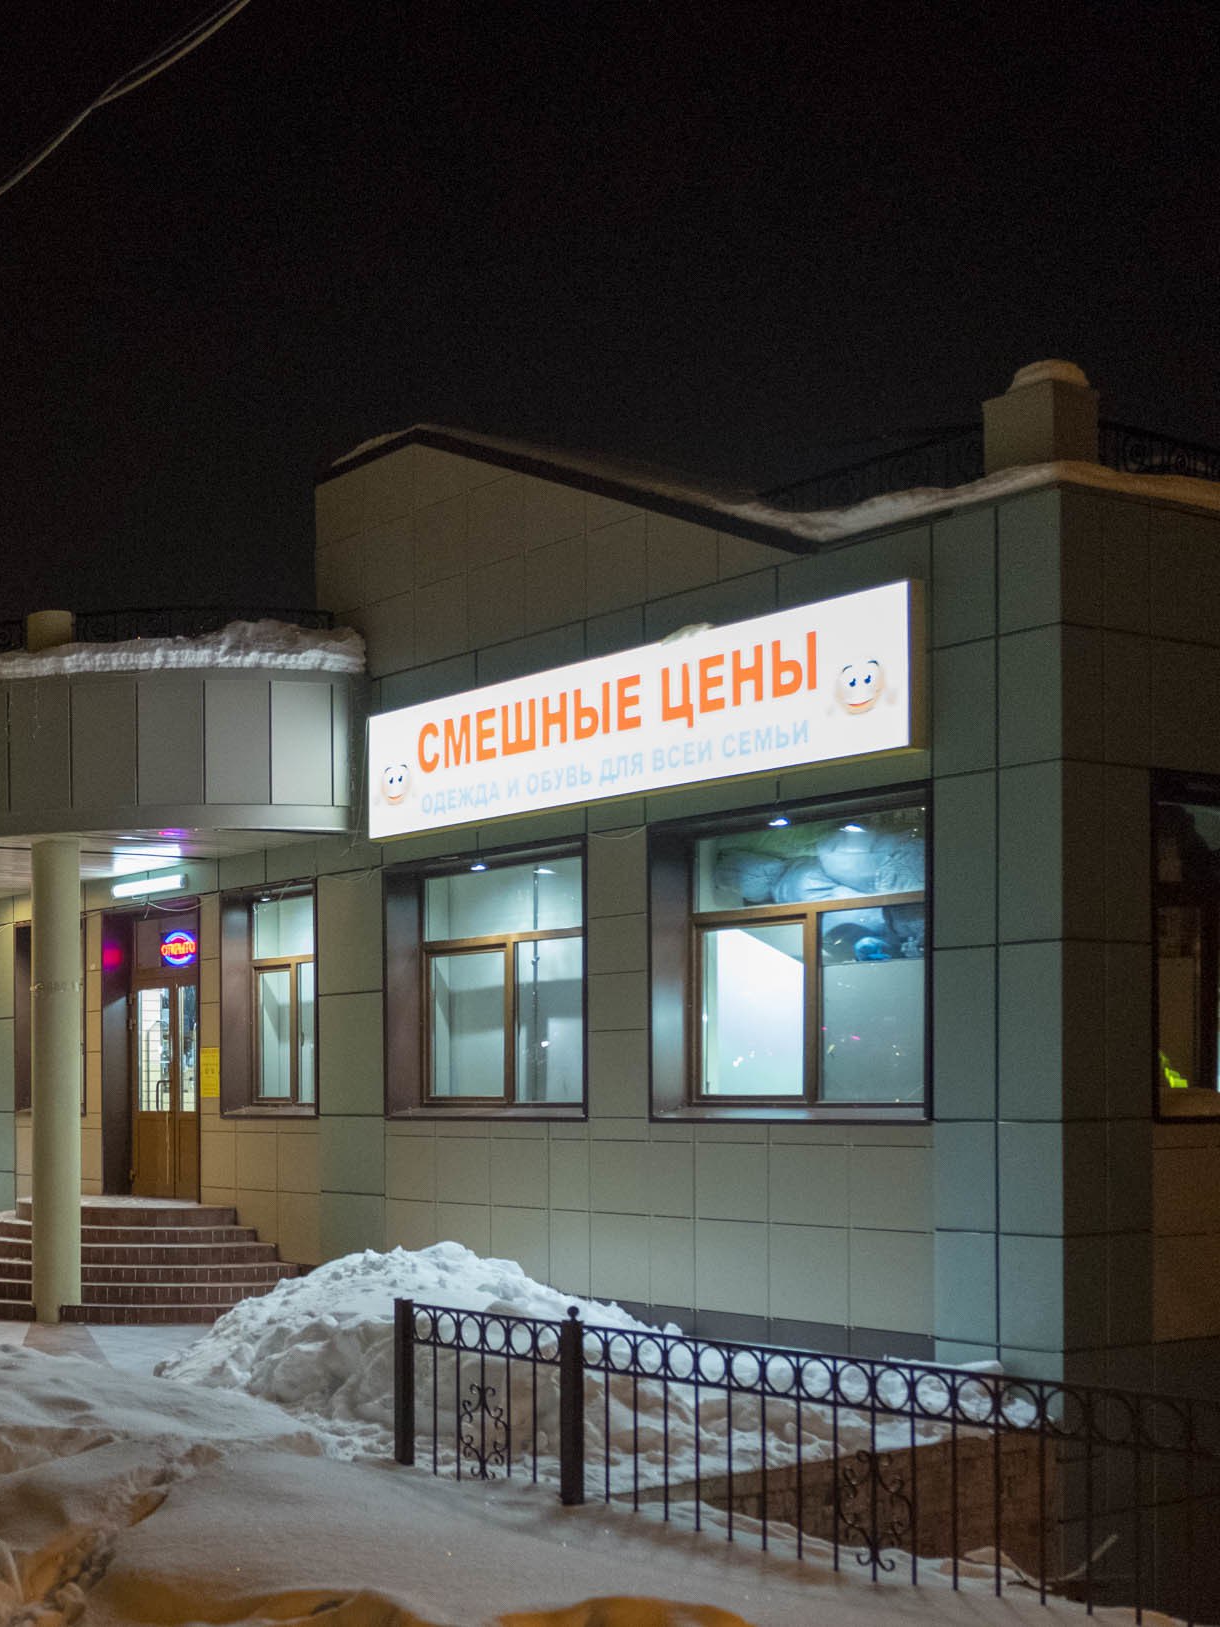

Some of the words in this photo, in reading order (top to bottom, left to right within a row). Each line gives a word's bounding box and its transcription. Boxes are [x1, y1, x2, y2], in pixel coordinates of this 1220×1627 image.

[417, 674, 641, 773] СМЕШНЫЕ
[660, 631, 818, 728] ЦЕНЫ
[421, 781, 500, 816] ОДЕЖДА
[507, 778, 520, 799] И
[526, 763, 593, 796] ОБУВЬ
[598, 751, 644, 787] ДЛЯ
[722, 719, 809, 759] СЕМЬИ
